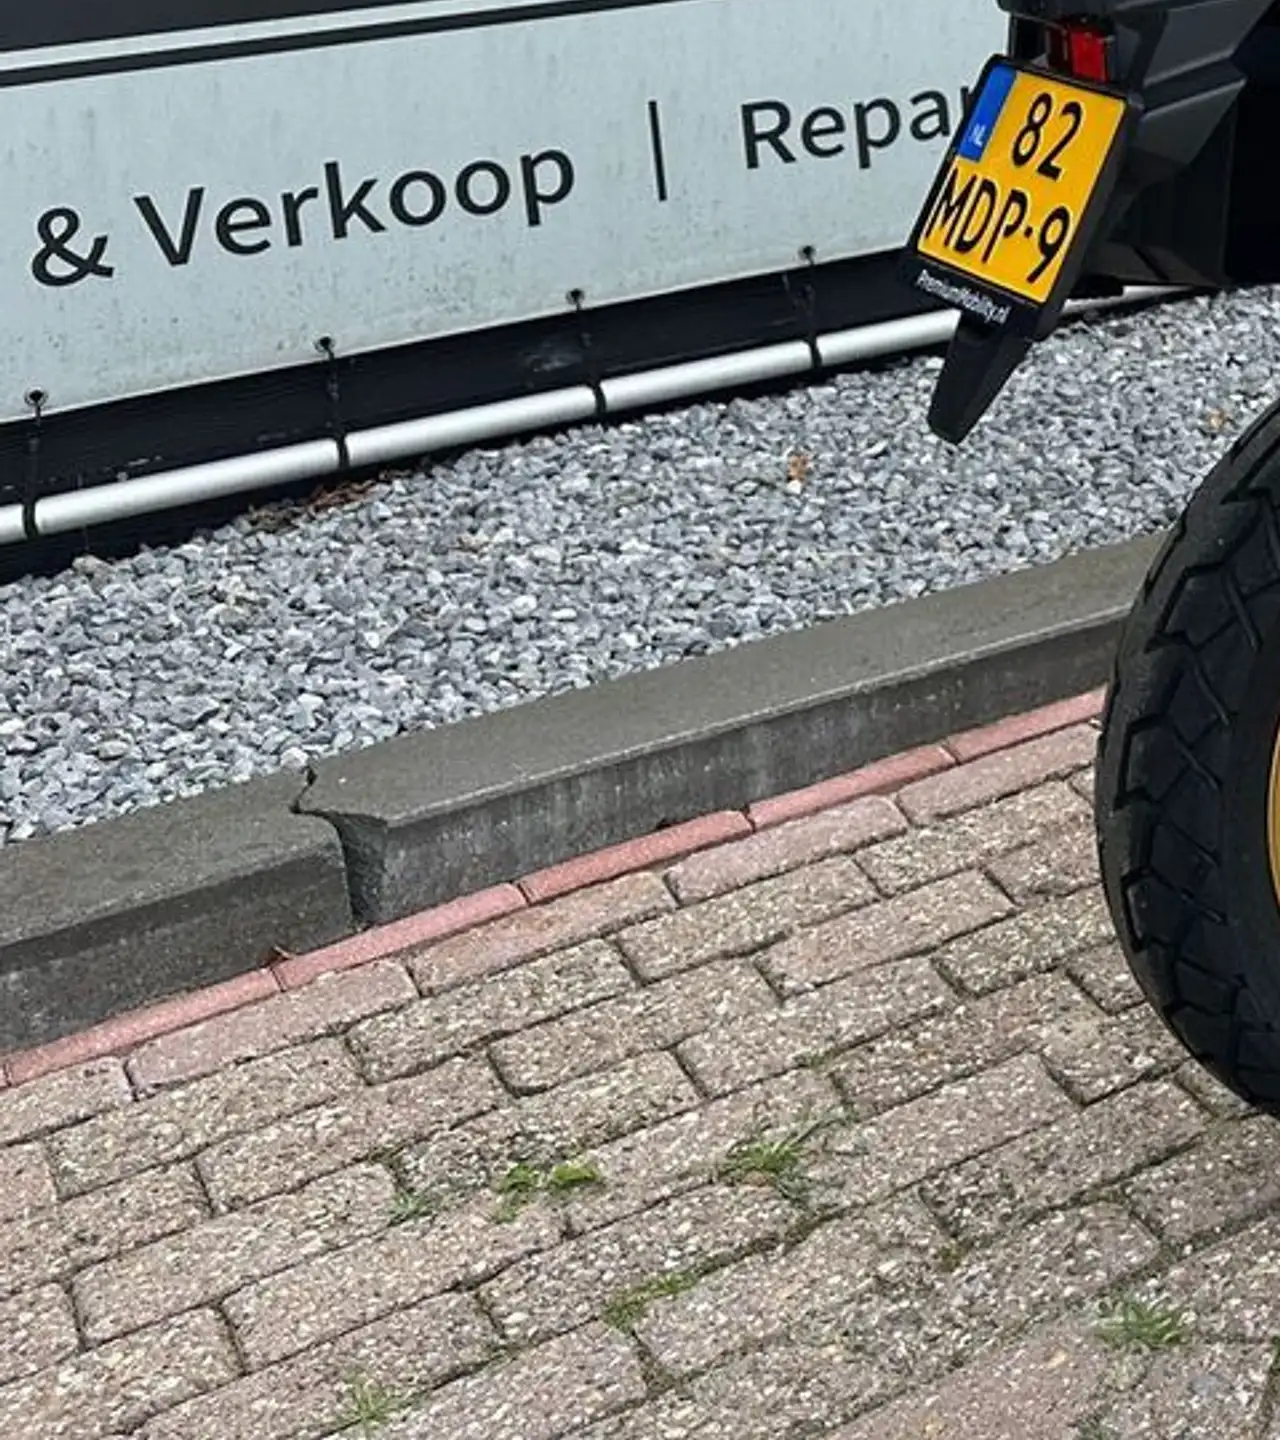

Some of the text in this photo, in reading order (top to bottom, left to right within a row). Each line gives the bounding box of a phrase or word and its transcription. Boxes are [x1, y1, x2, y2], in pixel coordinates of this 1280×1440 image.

[1011, 92, 1082, 181] 82
[32, 207, 114, 287] &
[133, 150, 574, 267] Verkoop
